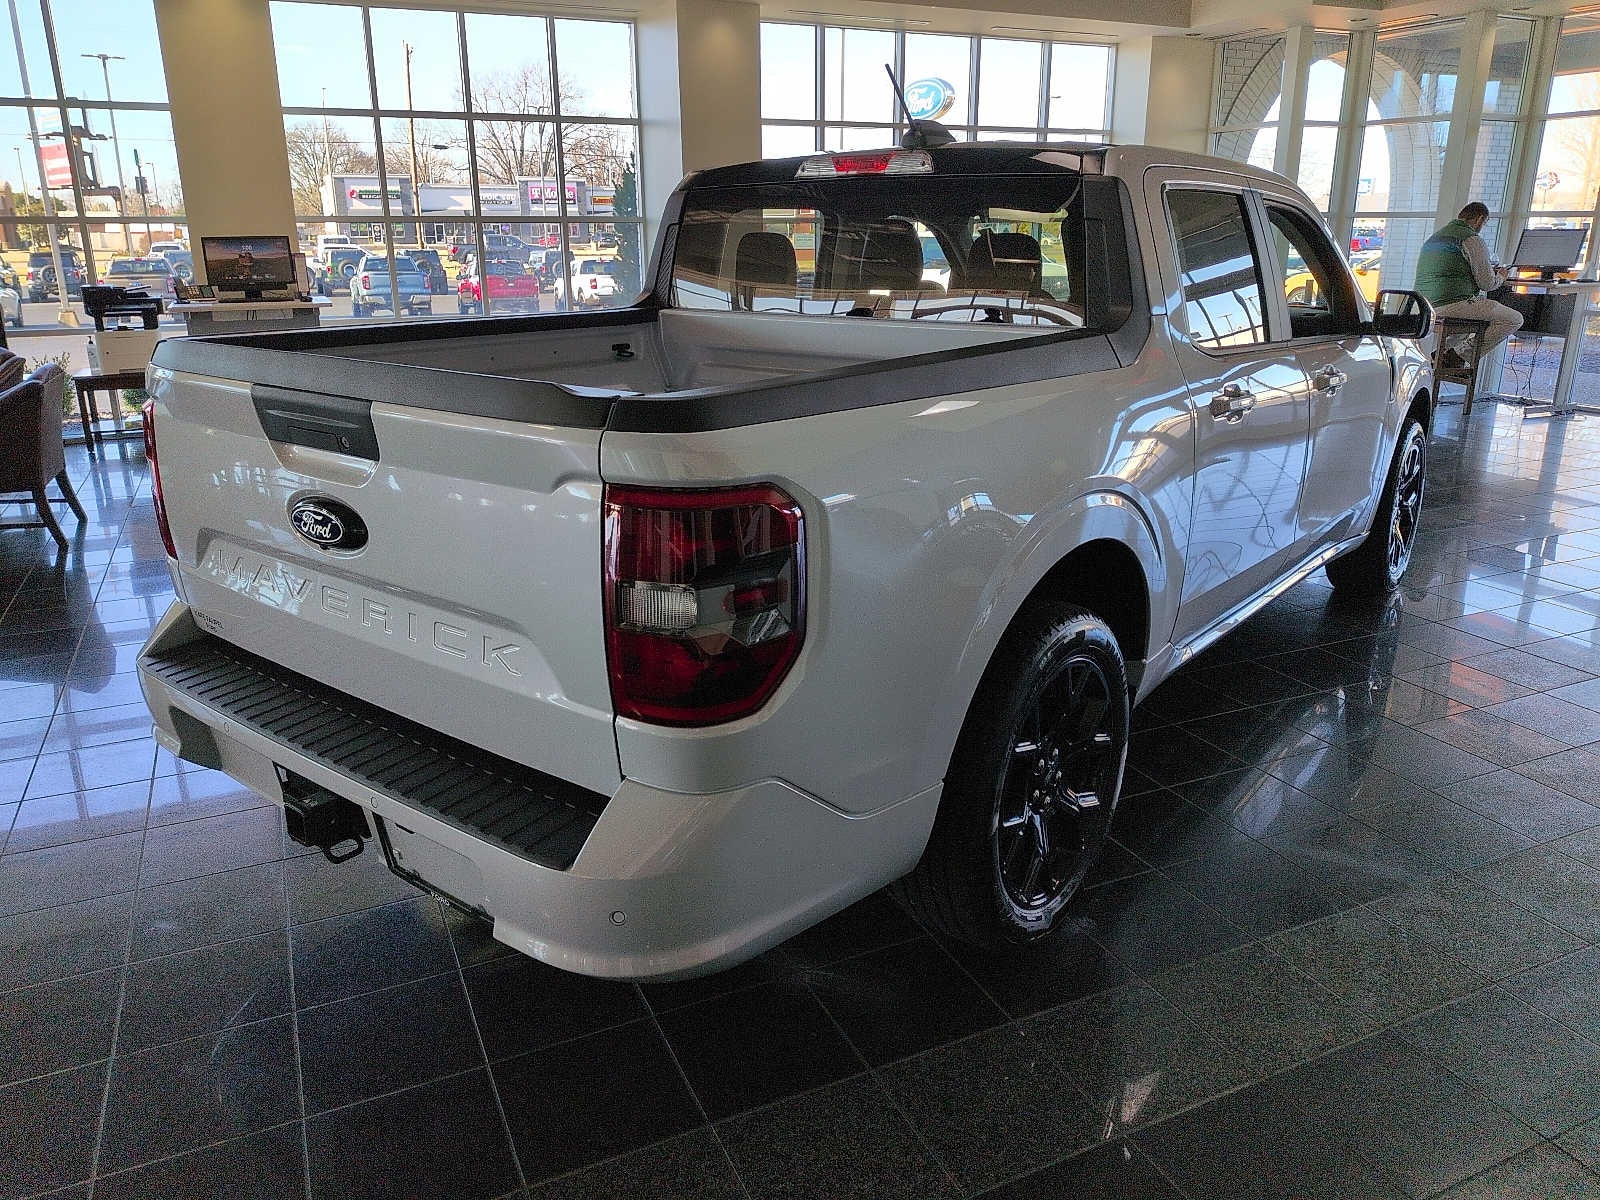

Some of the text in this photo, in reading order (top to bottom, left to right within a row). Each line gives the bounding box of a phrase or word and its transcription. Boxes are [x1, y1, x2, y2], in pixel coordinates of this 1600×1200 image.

[908, 87, 936, 113] Ford
[544, 187, 575, 200] Mole
[301, 510, 333, 539] Ford
[217, 548, 522, 677] MAVERICK
